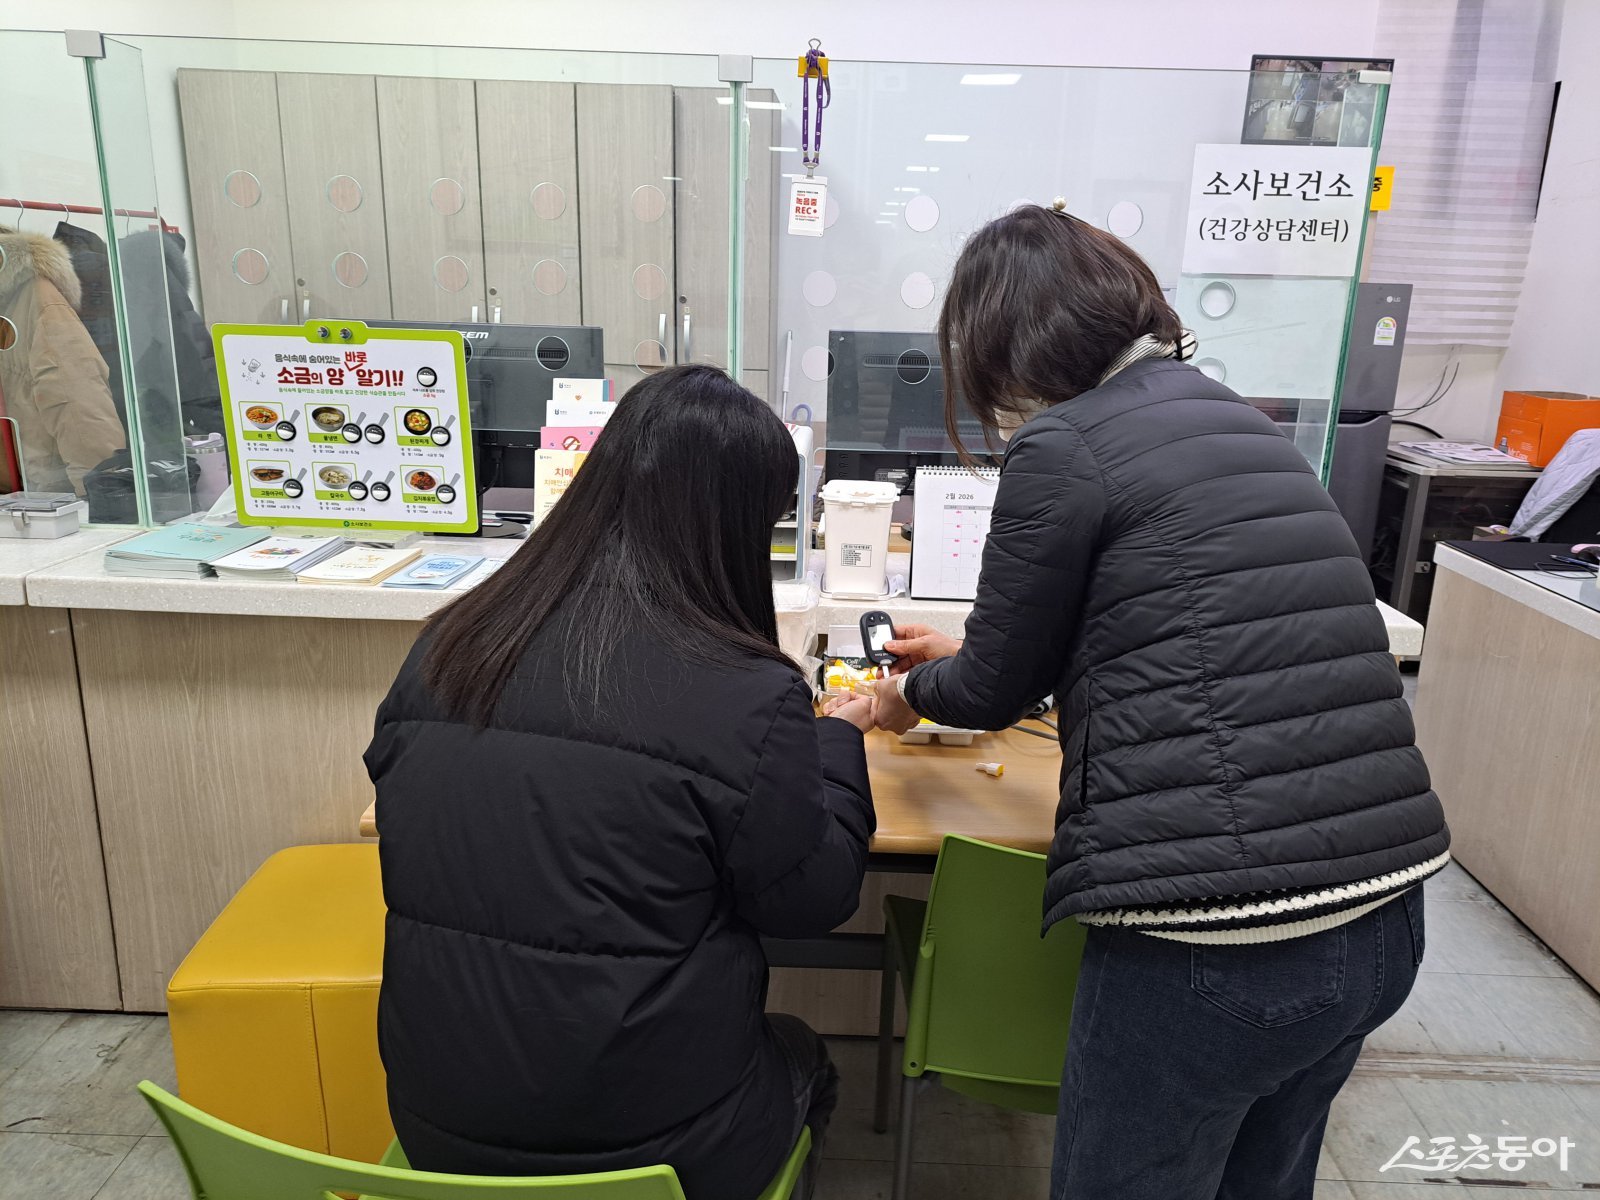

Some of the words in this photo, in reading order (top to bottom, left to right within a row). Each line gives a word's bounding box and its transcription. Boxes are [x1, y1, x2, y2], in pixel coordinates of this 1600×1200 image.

[1202, 169, 1354, 201] 소사보건소
[795, 206, 812, 214] REC
[1199, 217, 1349, 243] (건강상담센터)
[274, 353, 308, 364] 음식속에
[309, 355, 341, 365] 숨어있는
[344, 351, 368, 363] 바로
[277, 366, 323, 385] 소금의
[326, 367, 345, 386] 양
[356, 368, 404, 388] 알기!!
[945, 492, 956, 501] 2월
[958, 493, 975, 501] 2026
